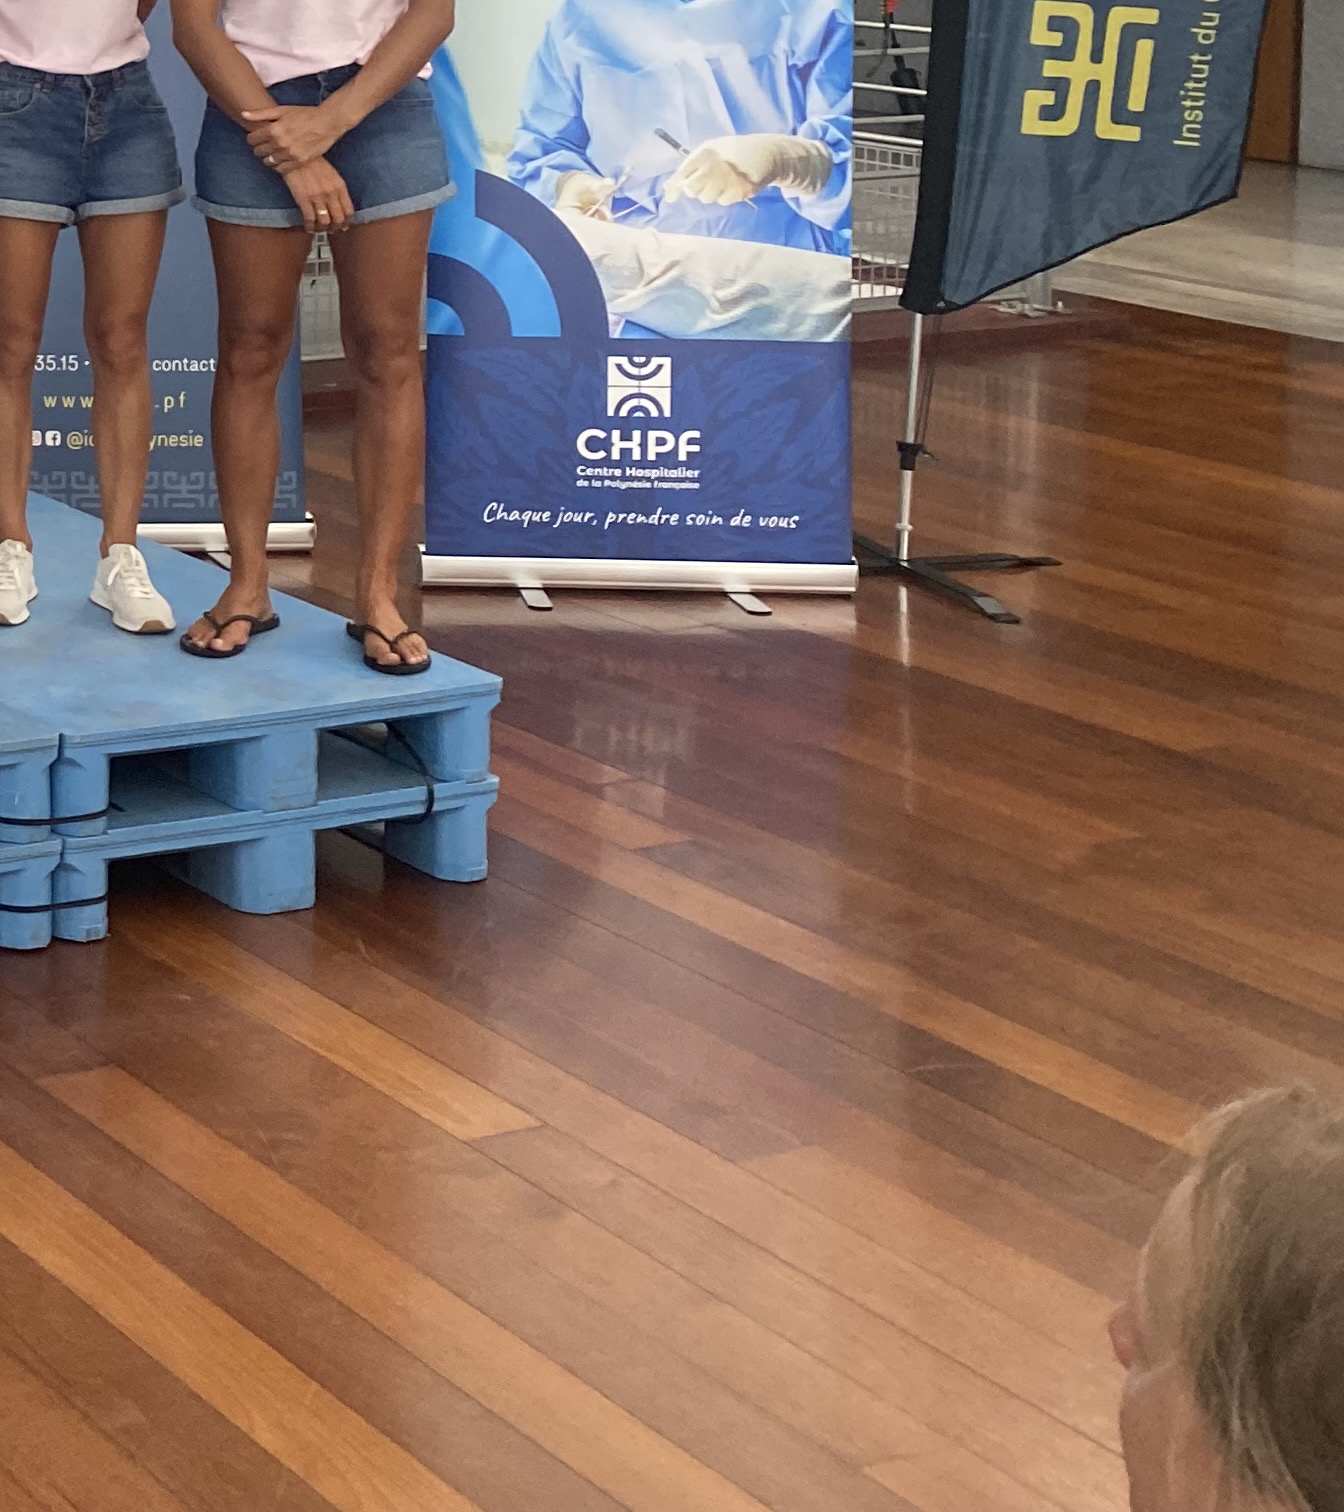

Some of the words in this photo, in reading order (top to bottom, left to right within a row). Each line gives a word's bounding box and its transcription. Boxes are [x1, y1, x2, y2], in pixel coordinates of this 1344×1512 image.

[1191, 11, 1220, 45] du
[1173, 53, 1212, 146] Institut
[576, 428, 701, 461] CHPF
[576, 466, 622, 477] Centre
[626, 467, 700, 479] Hospitalier
[576, 479, 589, 487] de
[591, 479, 601, 487] la
[483, 502, 551, 528] Chaque
[553, 506, 597, 528] jour,
[604, 507, 679, 529] prendre
[686, 510, 723, 525] soin
[729, 509, 751, 527] de
[759, 514, 799, 529] vous
